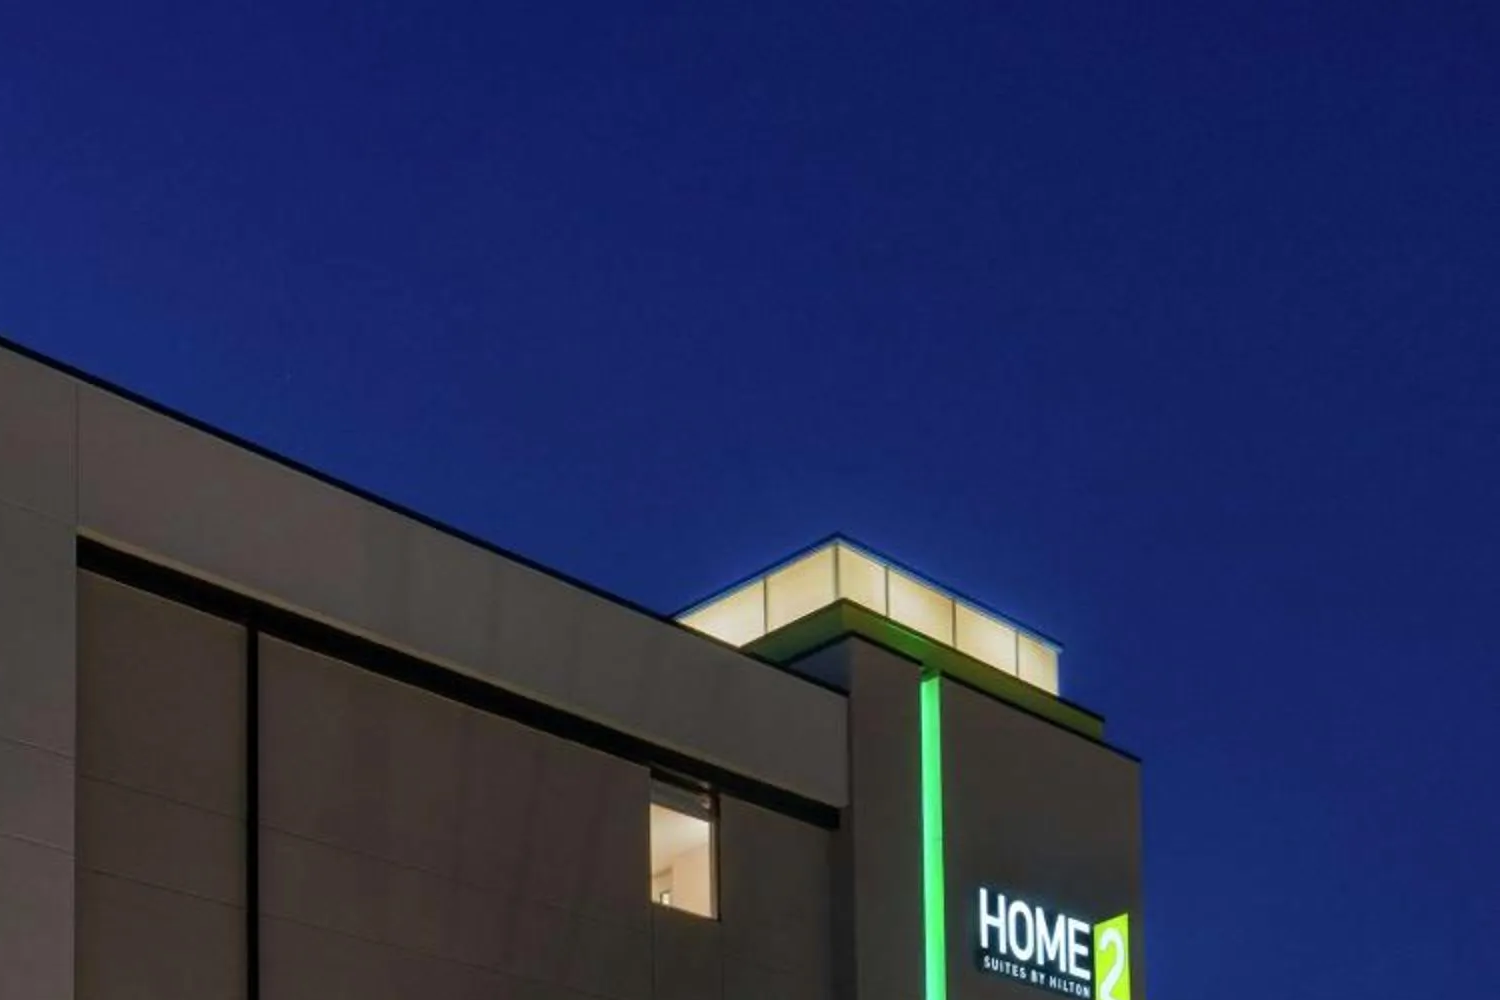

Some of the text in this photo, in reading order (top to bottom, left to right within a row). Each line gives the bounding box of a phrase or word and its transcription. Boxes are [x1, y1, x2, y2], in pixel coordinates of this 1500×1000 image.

[979, 887, 1092, 981] HOME
[983, 955, 1091, 999] SUITES BY HILTON
